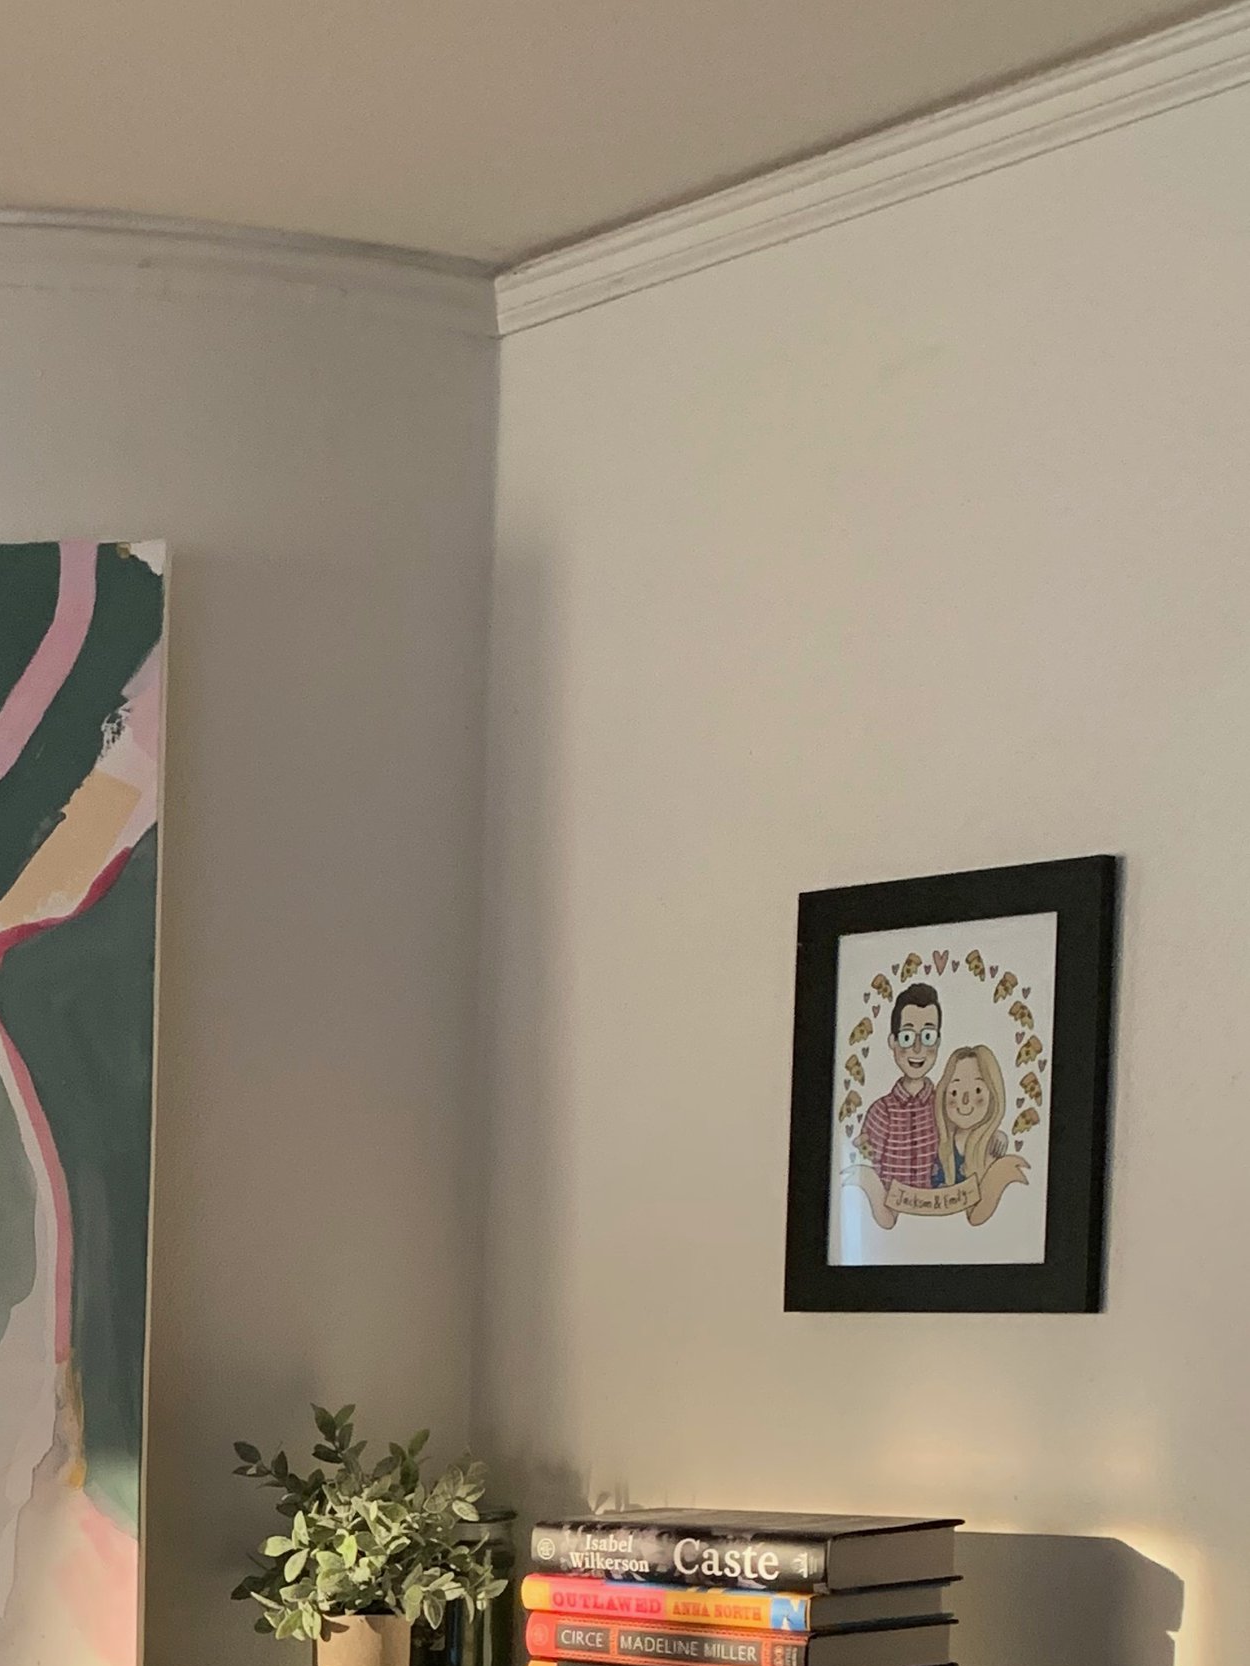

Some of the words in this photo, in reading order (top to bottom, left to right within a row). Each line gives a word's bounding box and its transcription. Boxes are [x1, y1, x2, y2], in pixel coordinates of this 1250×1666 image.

[585, 1534, 634, 1552] Isabel
[569, 1551, 650, 1574] Wilkerson
[673, 1537, 780, 1581] Caste
[552, 1591, 662, 1614] OUTLAWED
[714, 1603, 762, 1621] NORTH
[561, 1629, 604, 1648] CIRCE
[619, 1635, 697, 1657] MADELINE
[704, 1641, 757, 1662] MILLER
